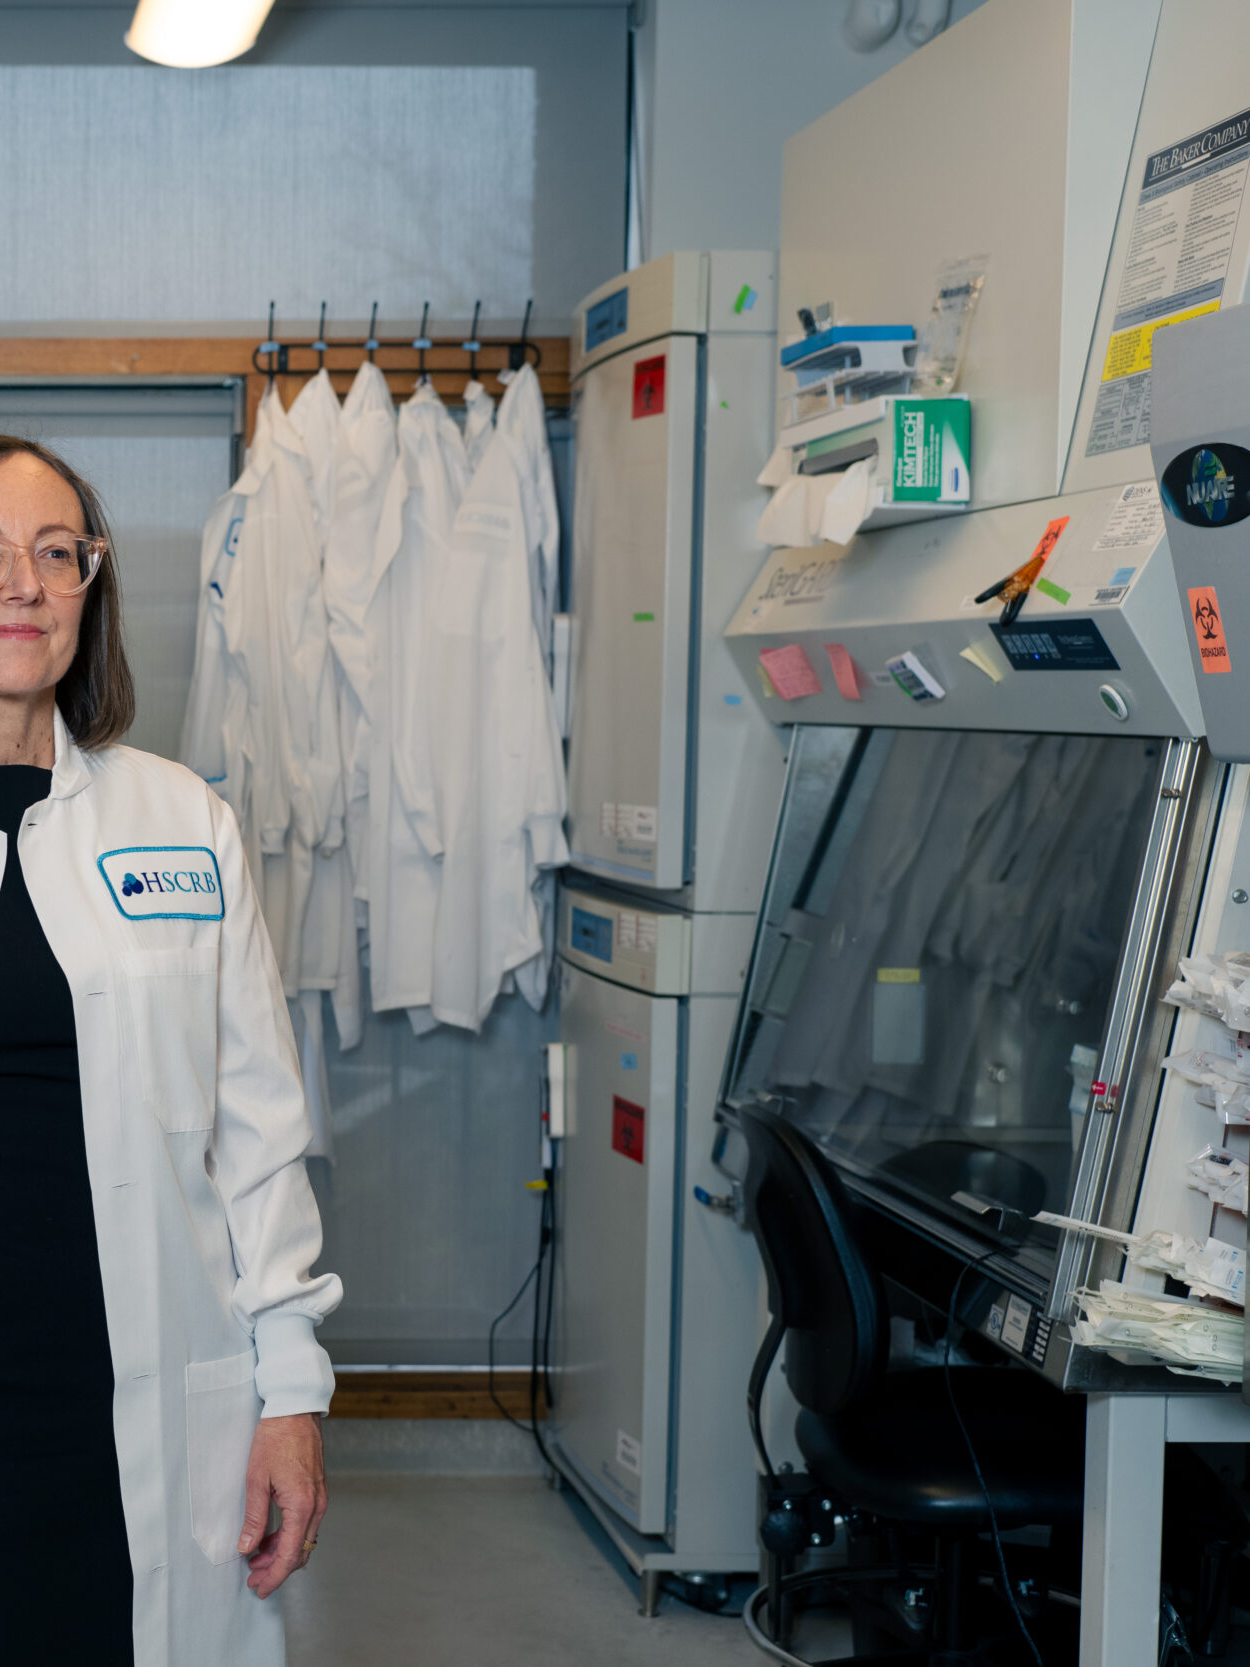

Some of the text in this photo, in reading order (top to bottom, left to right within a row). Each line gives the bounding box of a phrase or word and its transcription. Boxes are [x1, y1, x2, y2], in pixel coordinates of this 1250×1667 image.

[1152, 119, 1248, 177] THE BAKER COMPANY
[903, 411, 917, 488] KIMTECH
[1201, 646, 1227, 658] BIOHAZARD
[140, 871, 217, 894] HSCRB
